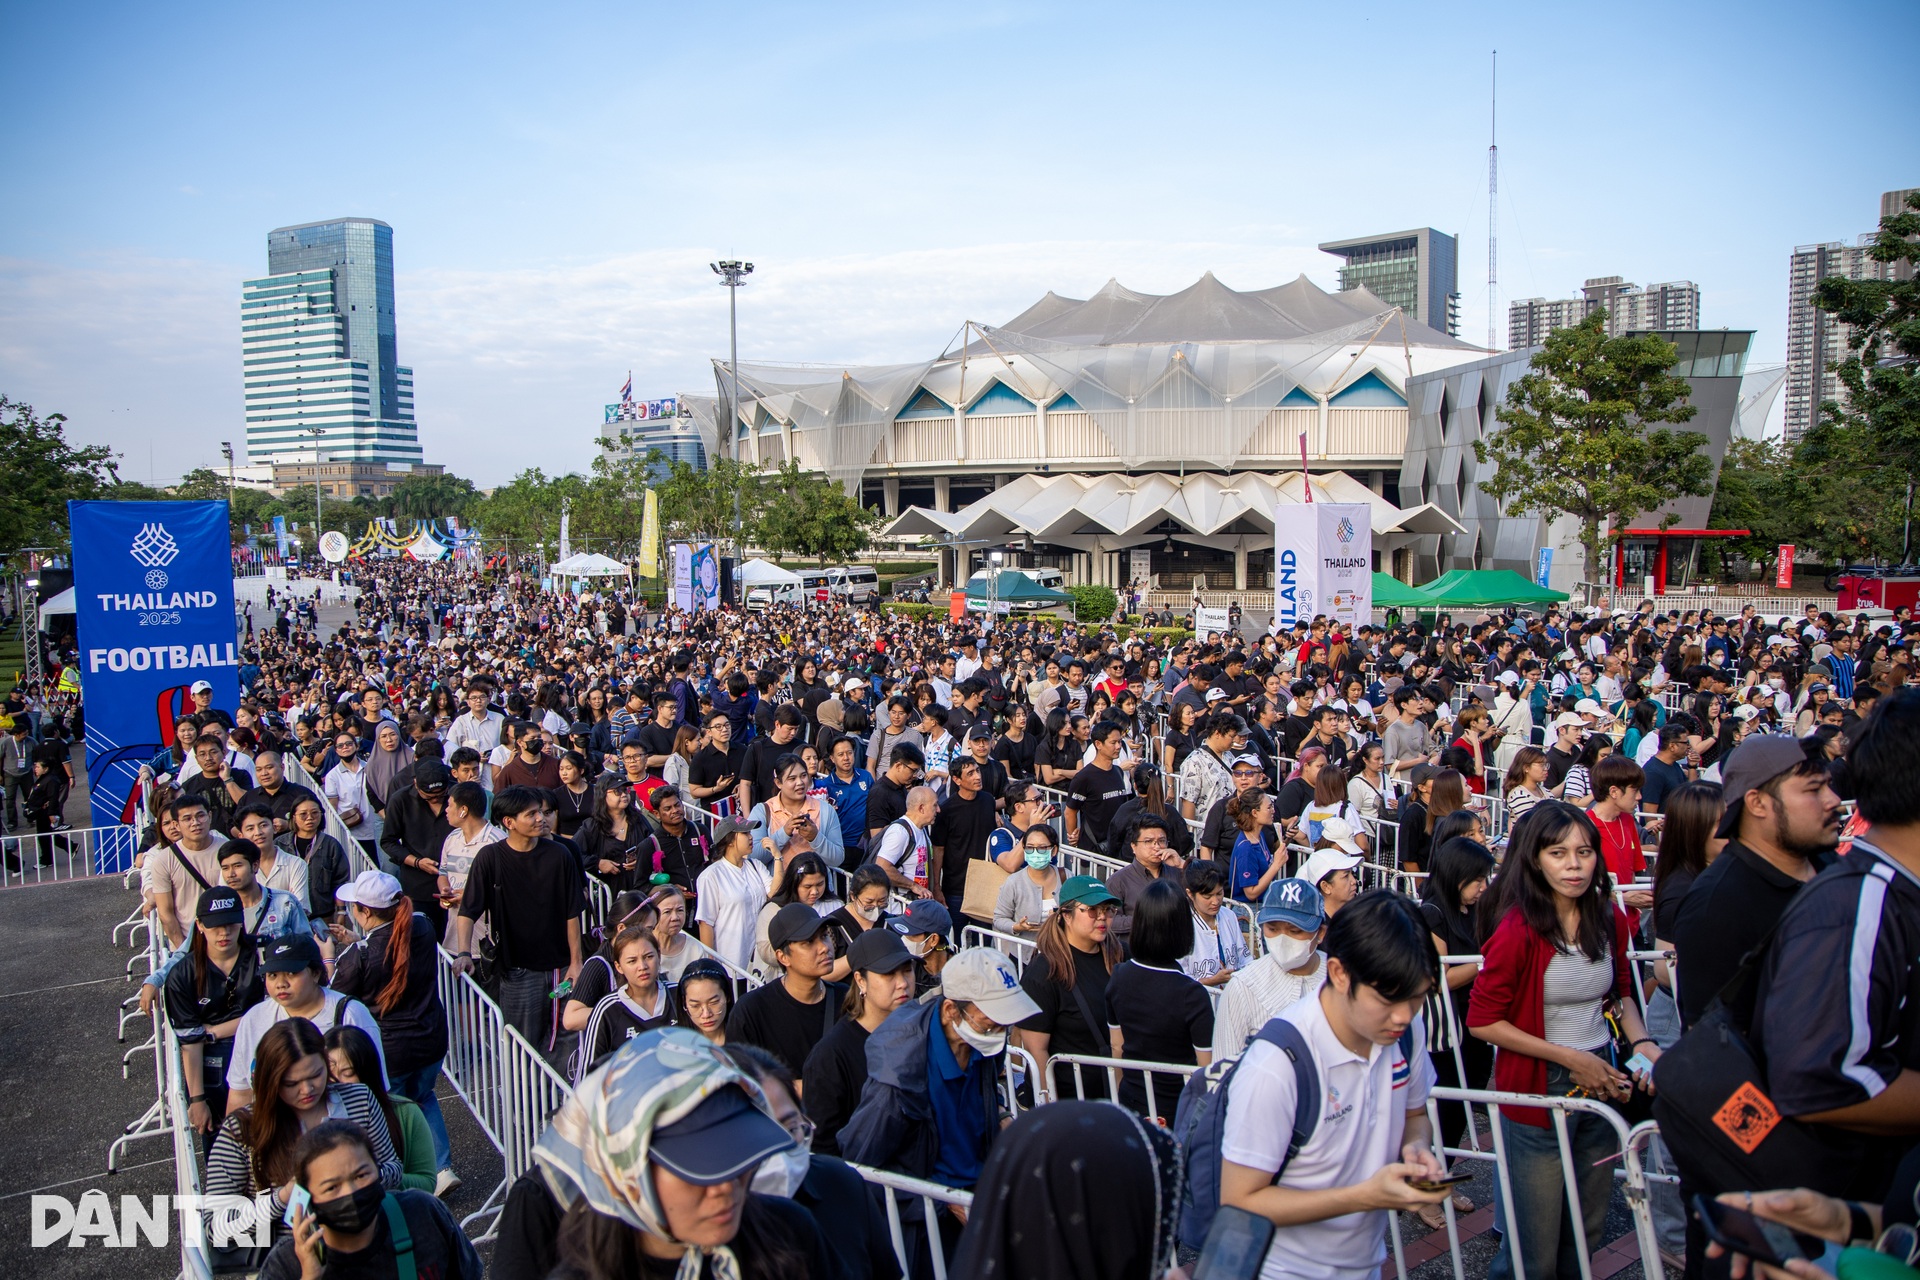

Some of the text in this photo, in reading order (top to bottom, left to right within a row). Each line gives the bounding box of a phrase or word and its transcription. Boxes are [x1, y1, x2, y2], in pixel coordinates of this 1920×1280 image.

[1324, 558, 1366, 568] THAILAND
[1337, 569, 1352, 577] 2025
[1280, 549, 1297, 632] ILAND
[97, 591, 217, 611] THAILAND
[1857, 598, 1874, 607] true
[138, 611, 181, 626] 2025
[90, 643, 238, 673] FOOTBALL
[1280, 882, 1302, 904] NY
[996, 967, 1017, 989] LA
[1323, 1104, 1353, 1124] THAILAND
